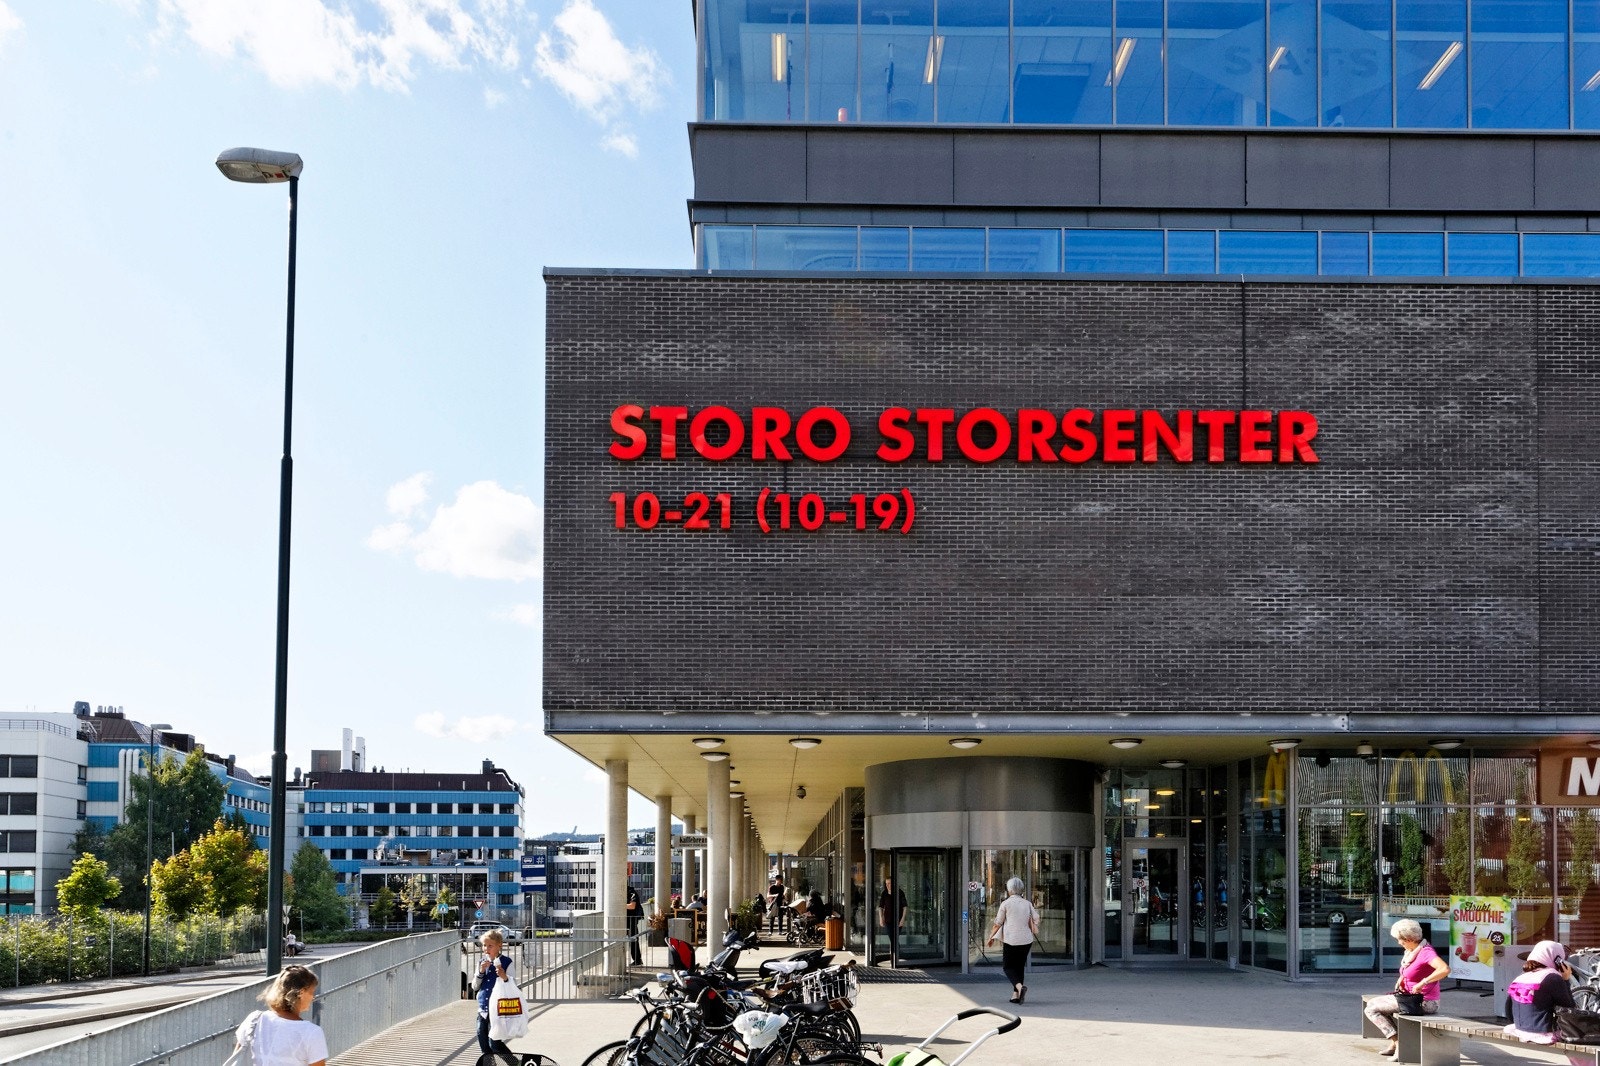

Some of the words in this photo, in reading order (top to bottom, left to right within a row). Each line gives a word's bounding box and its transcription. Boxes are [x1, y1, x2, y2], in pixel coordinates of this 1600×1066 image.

[608, 404, 851, 461] STORO
[876, 407, 1320, 464] STORSENTER
[608, 492, 732, 529] 10-21
[756, 487, 916, 534] (10-19)
[1453, 909, 1505, 924] SMOOTHIE
[1465, 901, 1492, 912] Frukt
